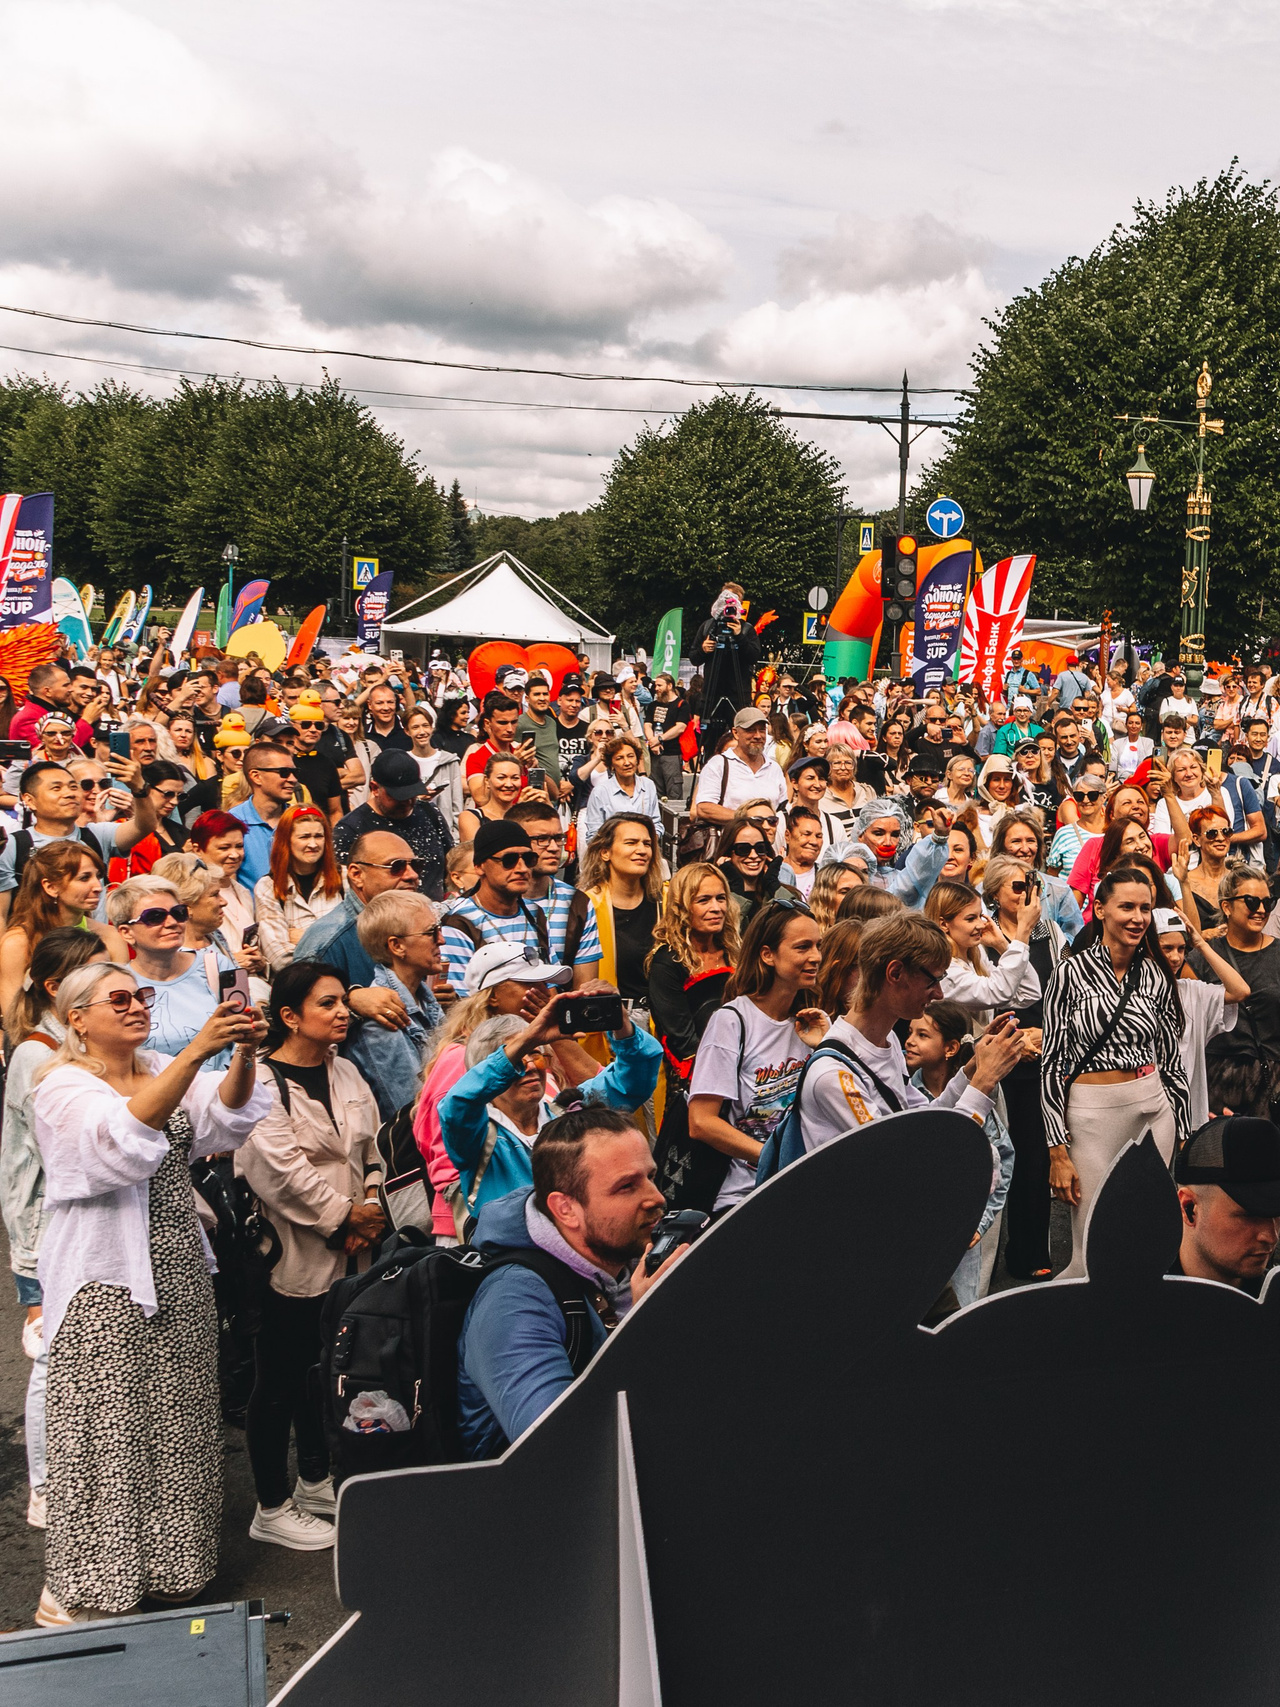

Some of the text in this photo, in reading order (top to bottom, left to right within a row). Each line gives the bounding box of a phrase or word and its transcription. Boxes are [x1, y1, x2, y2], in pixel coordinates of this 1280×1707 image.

[1, 601, 34, 615] SUP
[364, 631, 380, 639] SUP
[926, 646, 948, 660] SUP
[981, 621, 1001, 697] льфа Банк
[559, 738, 587, 750] OST
[754, 1060, 786, 1084] West
